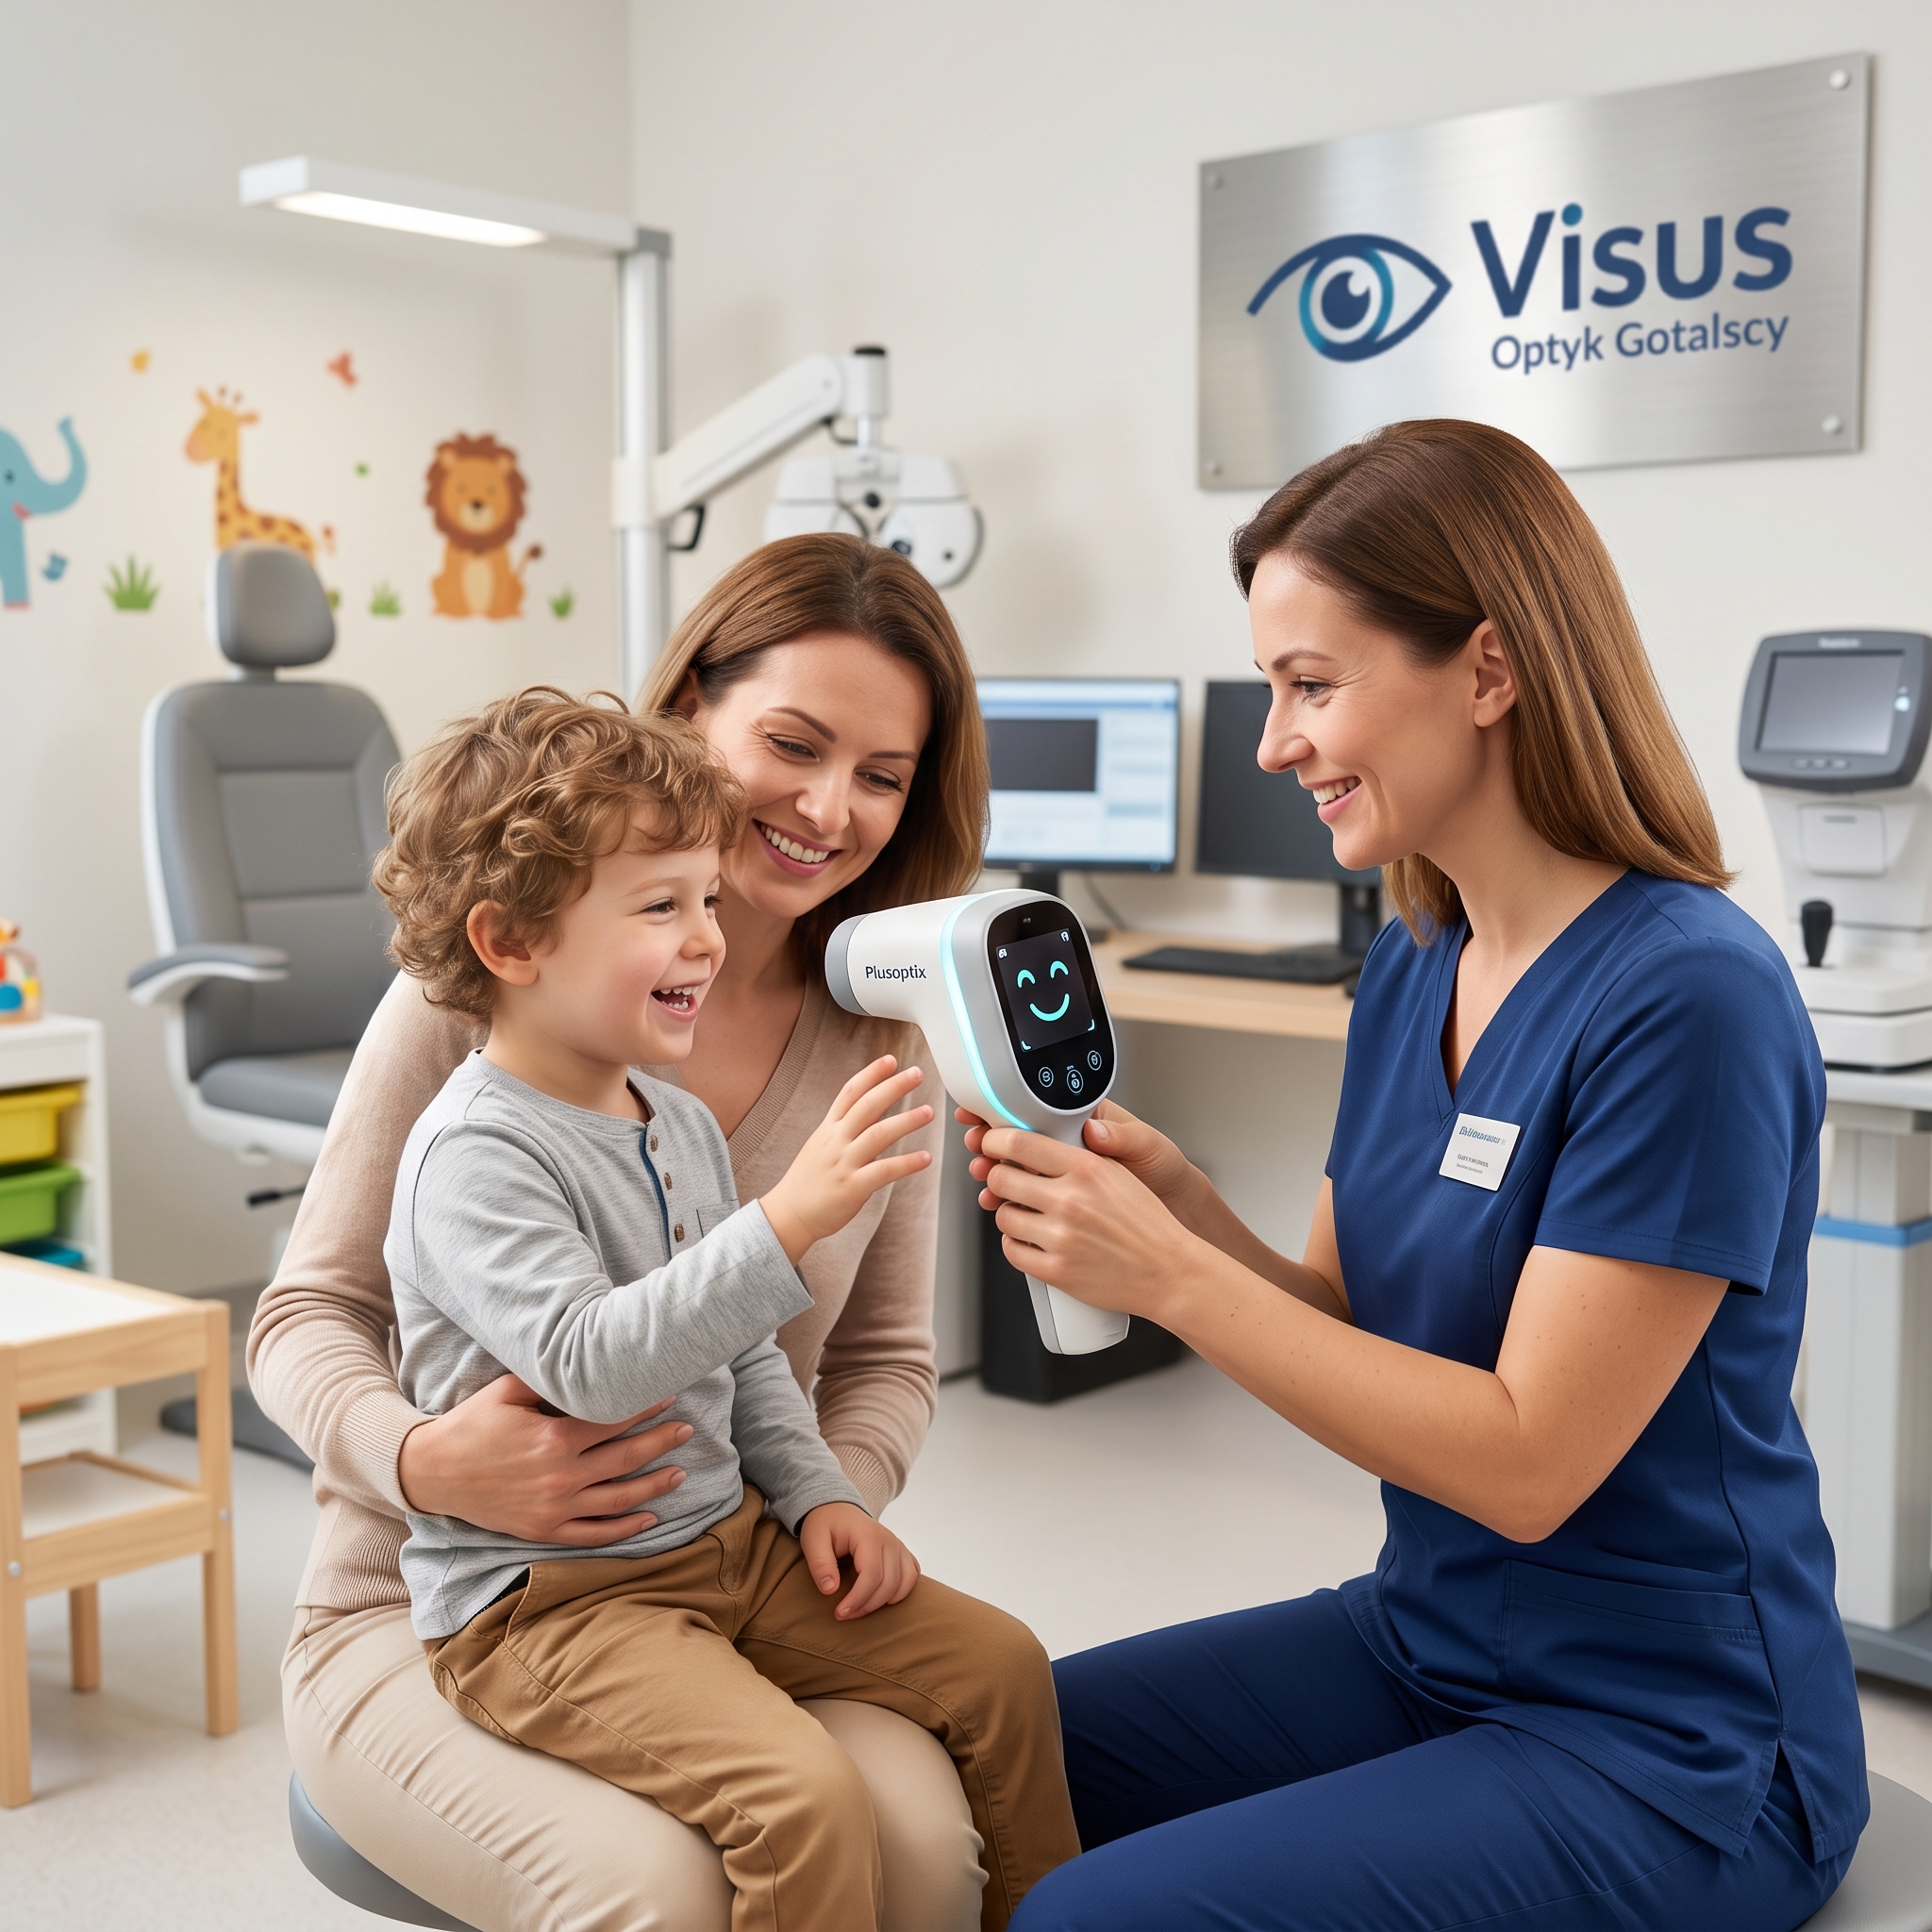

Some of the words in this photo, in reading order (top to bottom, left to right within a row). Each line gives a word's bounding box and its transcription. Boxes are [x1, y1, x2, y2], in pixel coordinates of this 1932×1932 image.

[1470, 203, 1793, 319] Visus
[1491, 327, 1604, 375] Optyk
[1614, 313, 1790, 358] Gotalscy
[865, 964, 927, 983] Plusoptix
